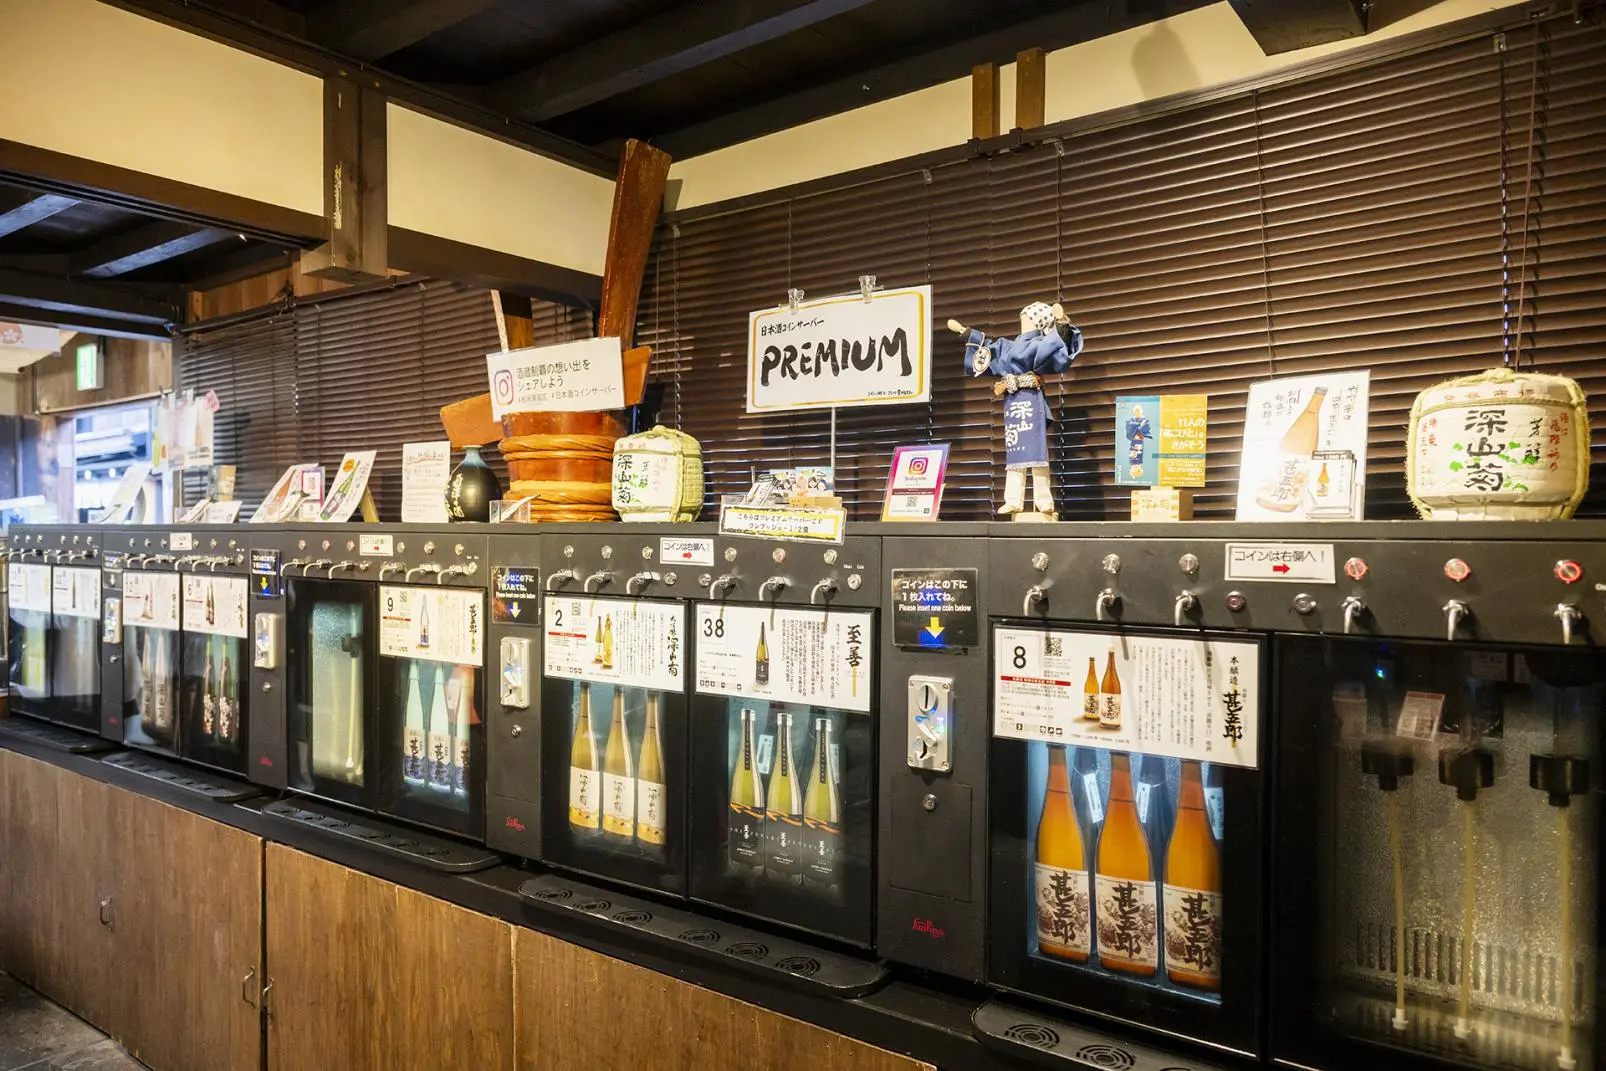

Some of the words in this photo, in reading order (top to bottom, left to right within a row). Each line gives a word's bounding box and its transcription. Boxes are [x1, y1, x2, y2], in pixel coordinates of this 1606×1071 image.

[761, 317, 825, 336] 日本酒コインサーバー
[761, 327, 912, 387] PREMIUM
[518, 376, 564, 392] シェアしよう
[1464, 410, 1508, 491] 深山菊
[617, 454, 633, 503] 深山菊
[1234, 551, 1325, 562] コインは右側へ！
[902, 580, 968, 589] コインはこの下に
[387, 597, 394, 612] 9
[555, 609, 563, 626] 2
[899, 604, 916, 612] Please
[703, 618, 725, 638] 38
[845, 624, 864, 668] 至善
[1013, 646, 1026, 669] 8
[1230, 655, 1239, 685] 本醸造
[1223, 690, 1243, 741] 甚五郎
[1049, 870, 1076, 944] 甚五郎
[1112, 881, 1142, 959] 甚五郎
[1181, 892, 1213, 972] 甚五郎
